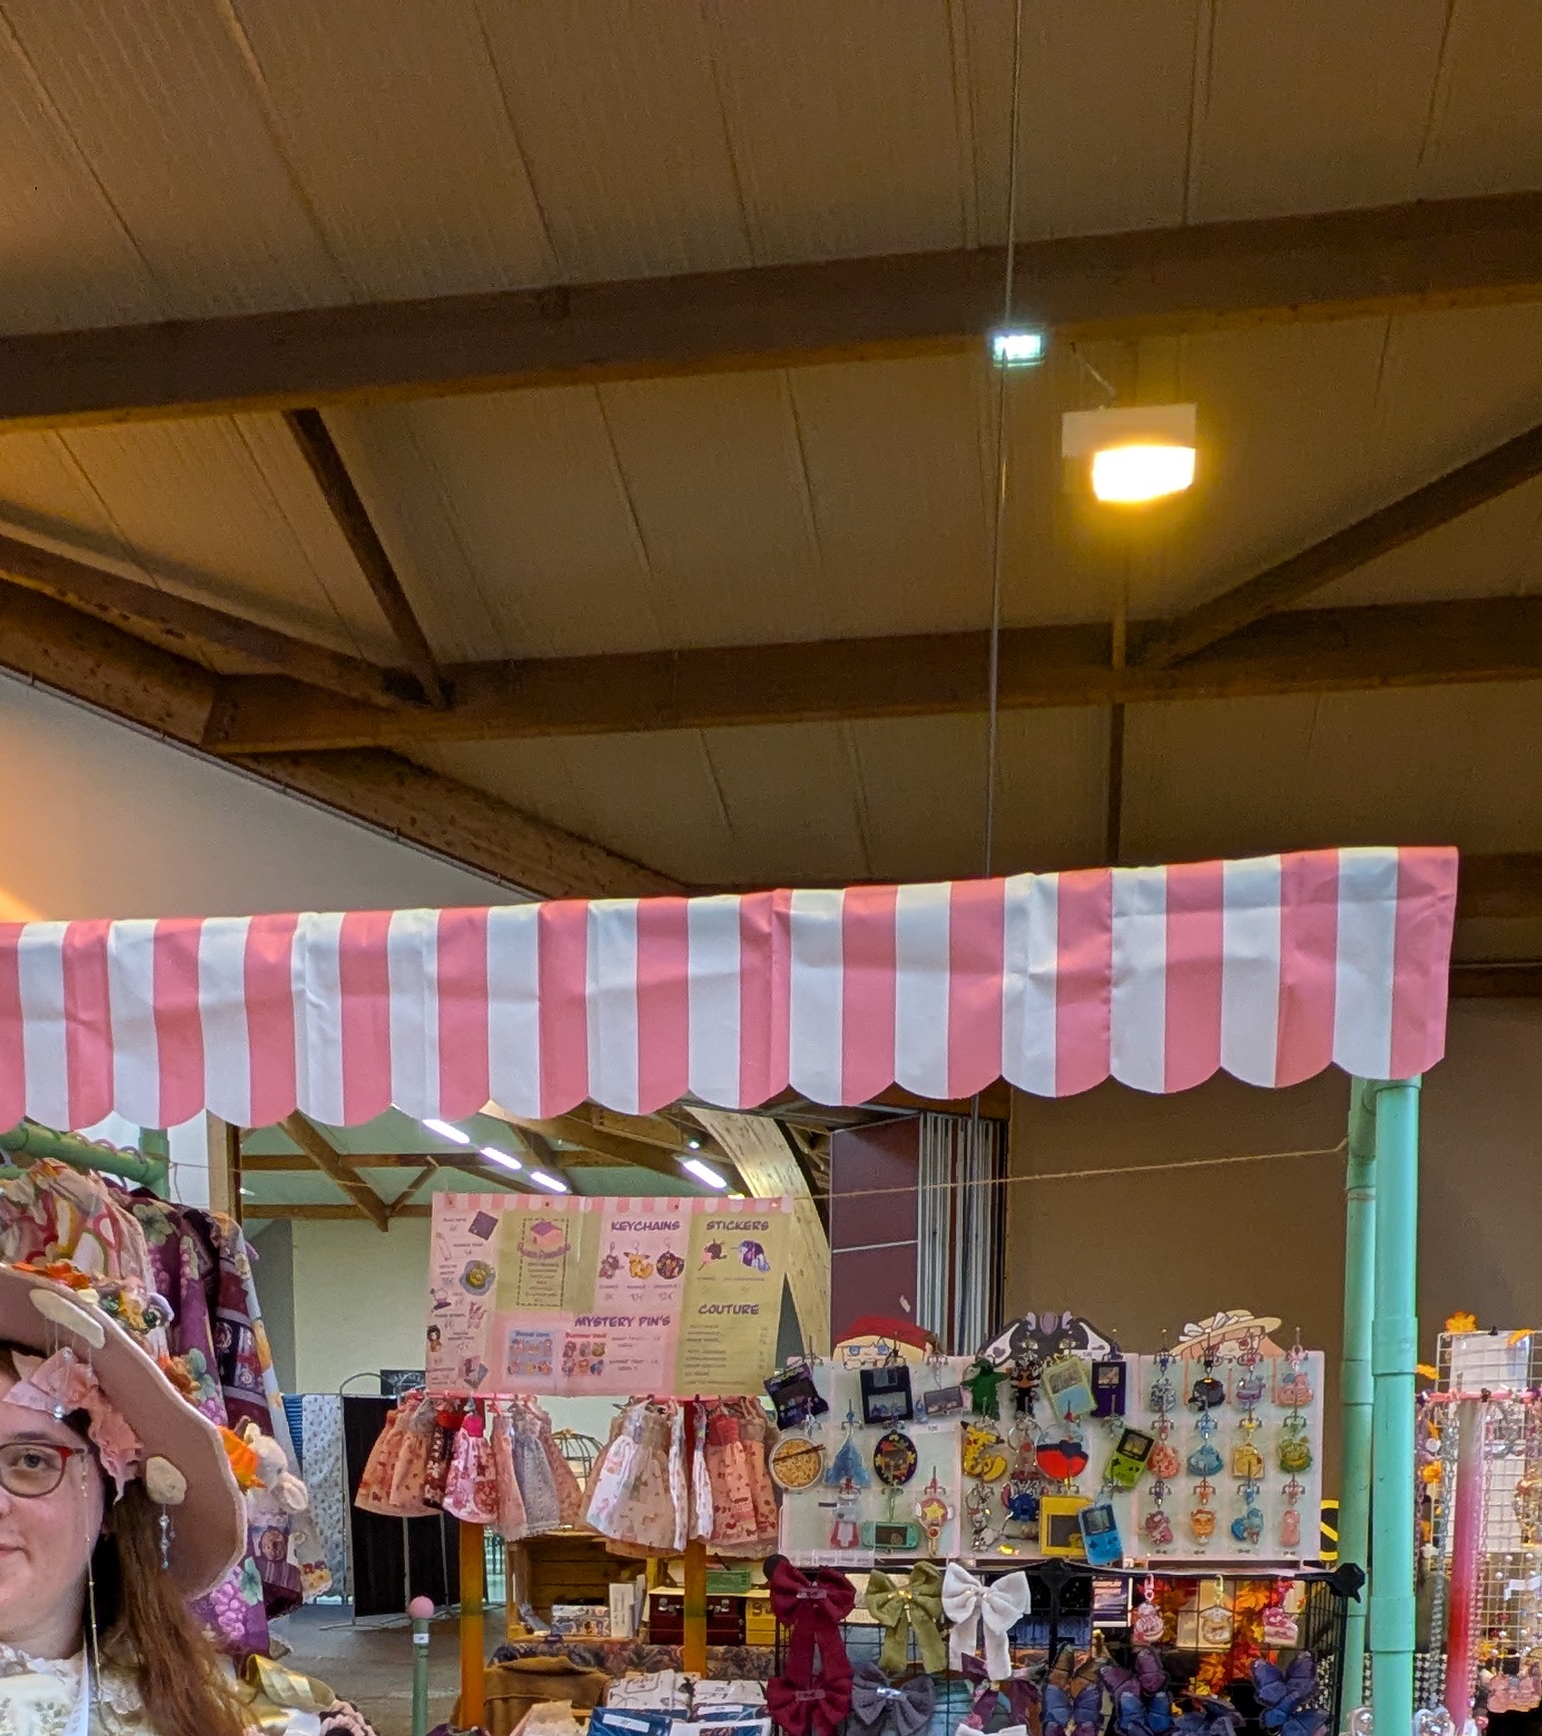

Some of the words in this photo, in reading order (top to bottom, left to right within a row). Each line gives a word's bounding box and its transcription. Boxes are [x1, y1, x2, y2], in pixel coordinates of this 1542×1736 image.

[610, 1220, 681, 1232] KEYCHAINS
[706, 1220, 770, 1232] STICKERS
[698, 1303, 760, 1315] COUTURE
[574, 1315, 636, 1328] MYSTERY
[638, 1315, 671, 1328] PIN'S
